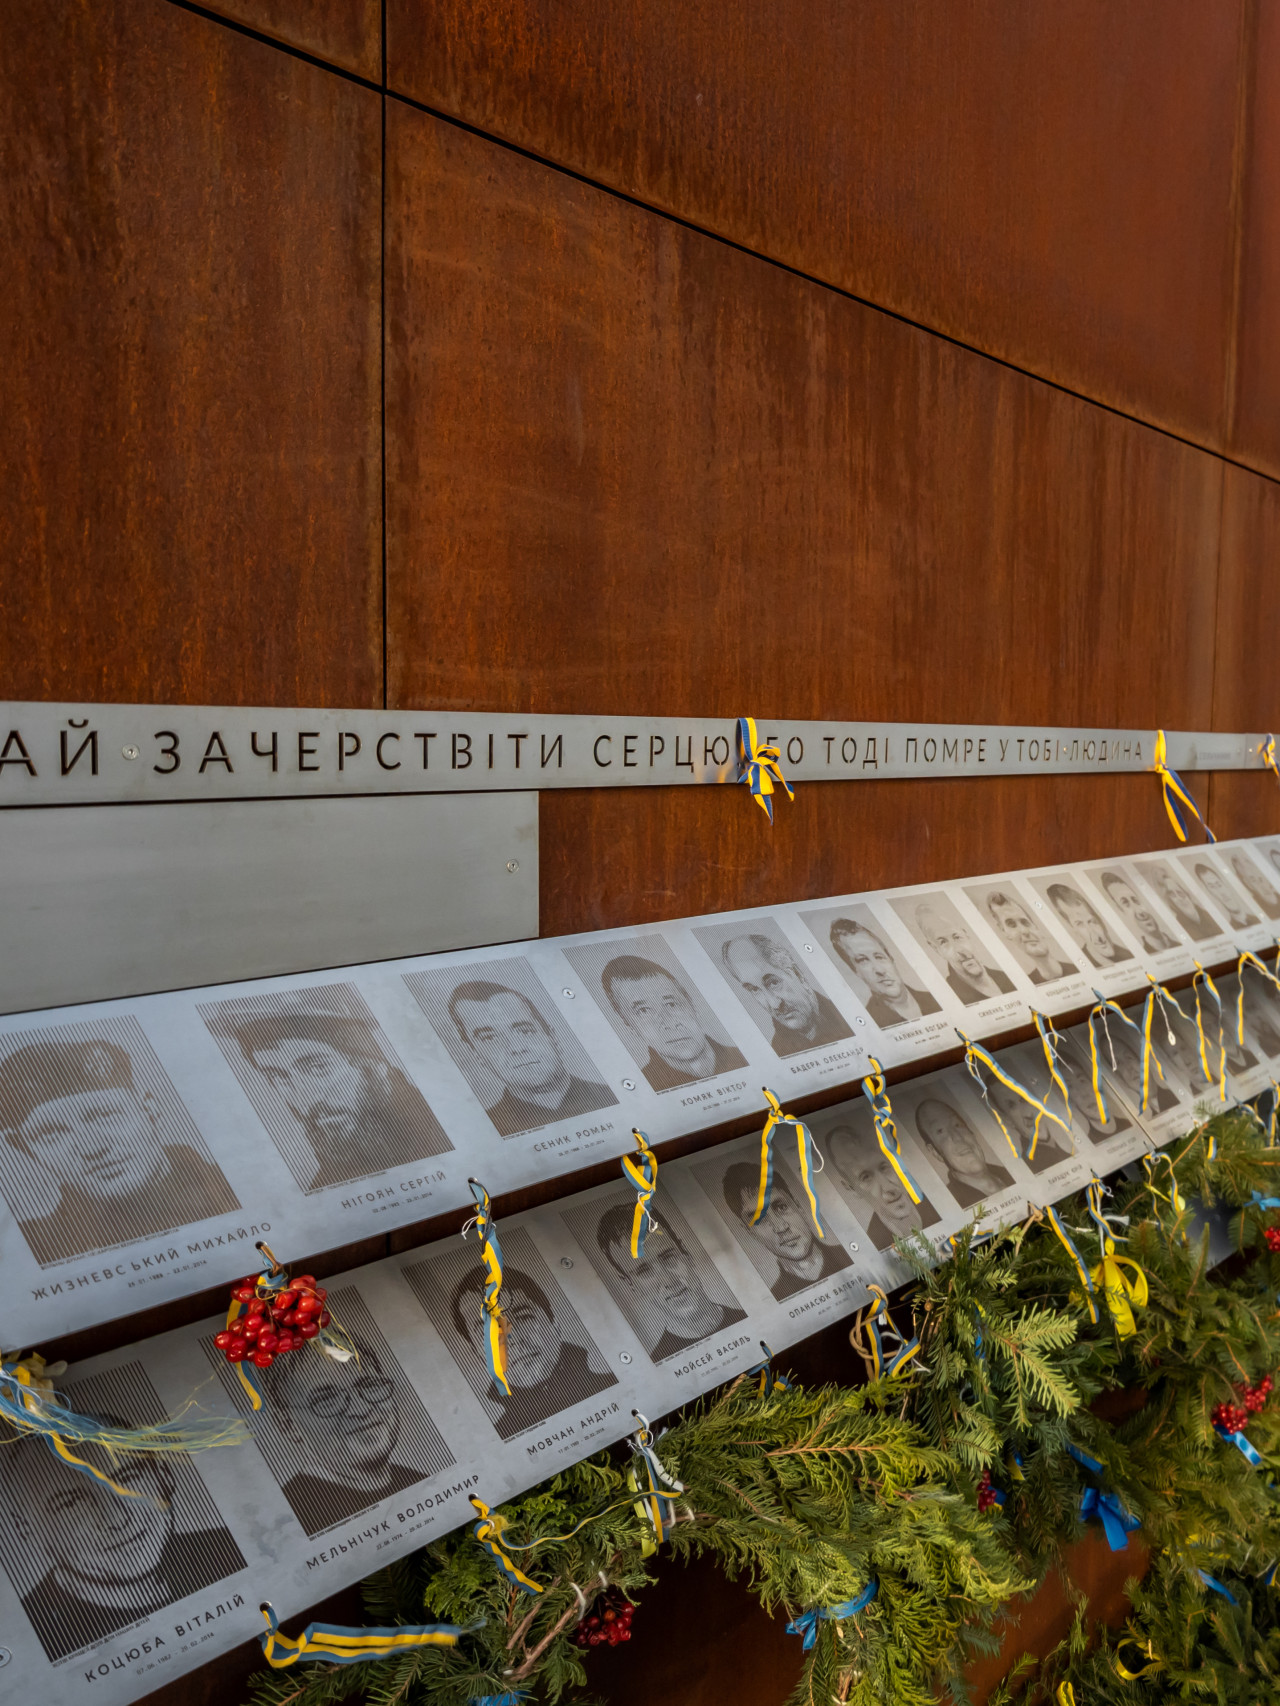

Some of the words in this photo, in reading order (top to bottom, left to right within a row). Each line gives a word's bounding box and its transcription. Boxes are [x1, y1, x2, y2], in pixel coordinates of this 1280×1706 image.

[152, 730, 564, 774] ЗАЧЕРСТВІТИ
[593, 734, 730, 773] СЕРЦЮ
[823, 737, 889, 769] ТОДІ
[905, 737, 987, 762] ПОМРЕ
[999, 738, 1009, 763] У
[1017, 739, 1060, 762] ТОБІ
[1069, 739, 1144, 763] ЛЮДИНА
[823, 1047, 865, 1064] ОЛЕКСАНДР
[680, 1092, 713, 1107] ХОМЯК
[717, 1081, 748, 1096] ВІКТОР
[534, 1135, 571, 1152] СЕНИК
[576, 1122, 615, 1140] РОМАН
[341, 1187, 395, 1210] НІГОЯН
[400, 1170, 447, 1192] СЕРГІЙ
[187, 1222, 272, 1254] МИХАЙЛО
[788, 1293, 831, 1319] ОПАНАСЮК
[674, 1353, 713, 1378] МОЙСЕЙ
[716, 1335, 751, 1356] ВАСИЛЬ
[526, 1427, 575, 1456] МОВЧАН
[580, 1402, 620, 1429] АНДРІЙ
[306, 1520, 390, 1570] МЕЛЬНІЧУК
[397, 1475, 480, 1523] ВОЛОДИМИР
[85, 1636, 165, 1683] КОЦЮБА
[174, 1594, 245, 1637] ВІТАЛІЙ
